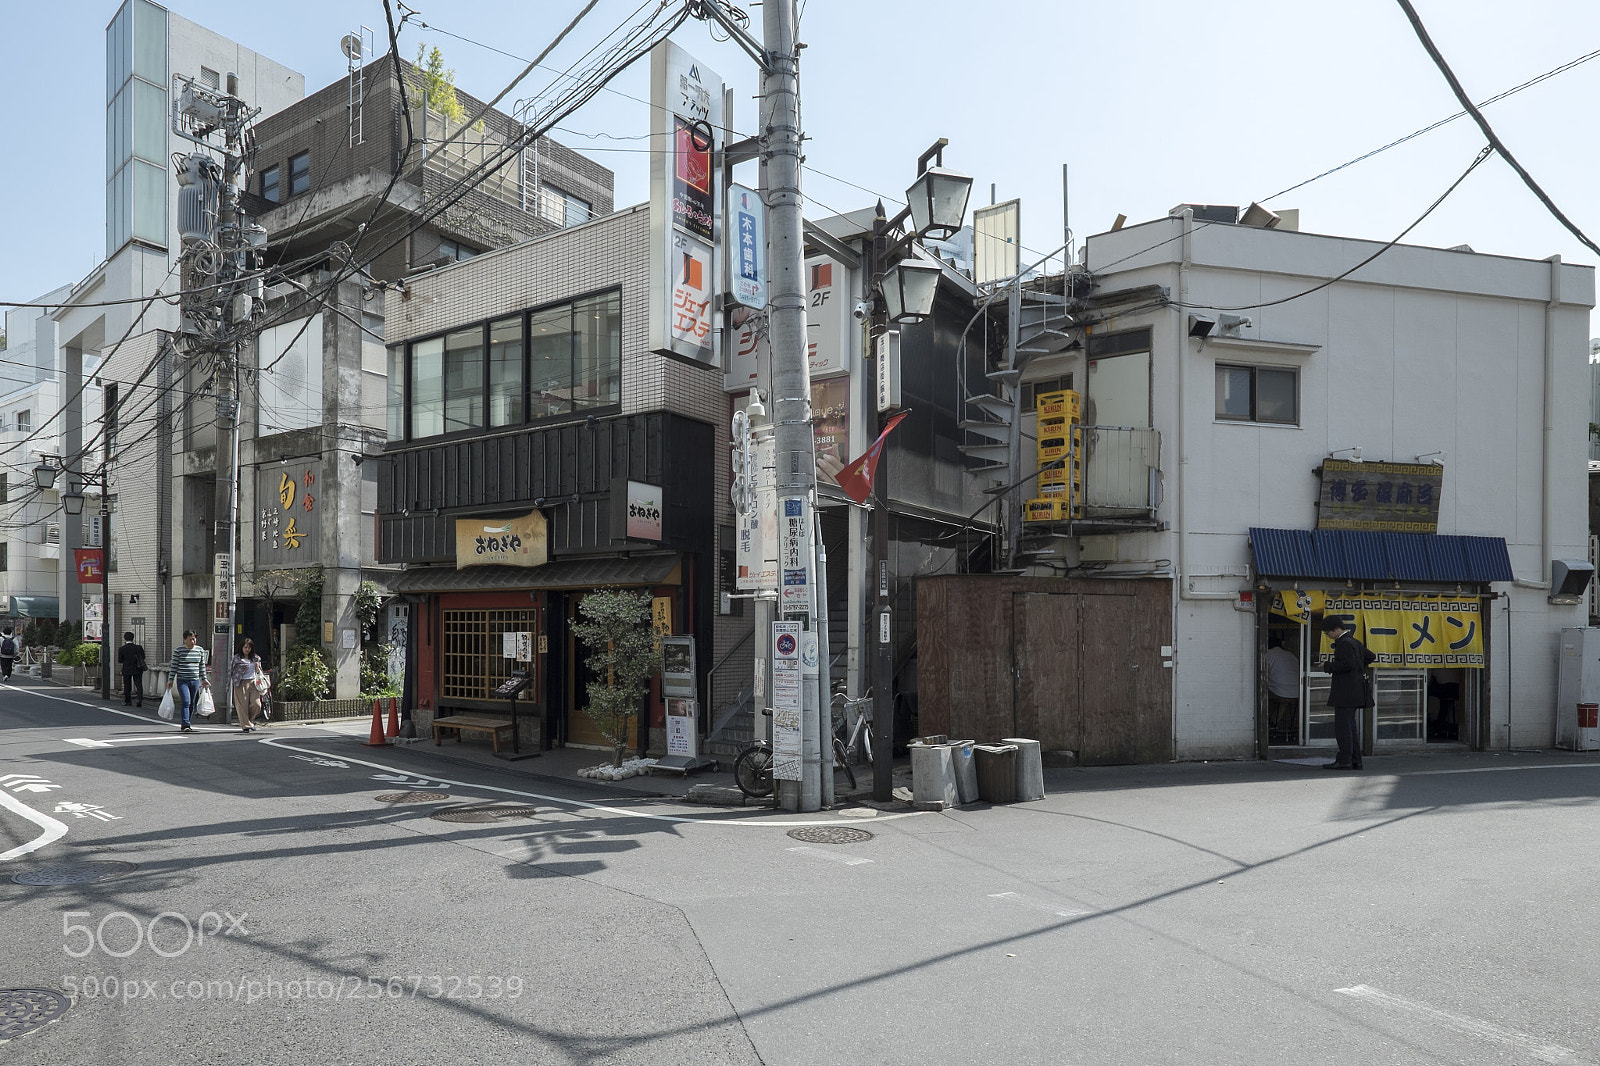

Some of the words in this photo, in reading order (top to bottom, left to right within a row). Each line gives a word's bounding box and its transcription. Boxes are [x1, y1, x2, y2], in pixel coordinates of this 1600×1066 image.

[674, 235, 688, 249] 2F
[742, 216, 755, 278] 木本歯科
[674, 288, 711, 317] ジェイ
[812, 291, 830, 307] 2F
[674, 312, 710, 338] エステ
[1043, 404, 1062, 412] KIRIN
[1043, 425, 1062, 434] KIRIN
[1044, 447, 1062, 455] KIRIN
[1044, 469, 1062, 478] KIRIN
[629, 503, 660, 521] おねぎや
[1032, 511, 1050, 520] KIRIN
[474, 534, 522, 555] おねぎや
[789, 518, 799, 567] 糖尿病内科
